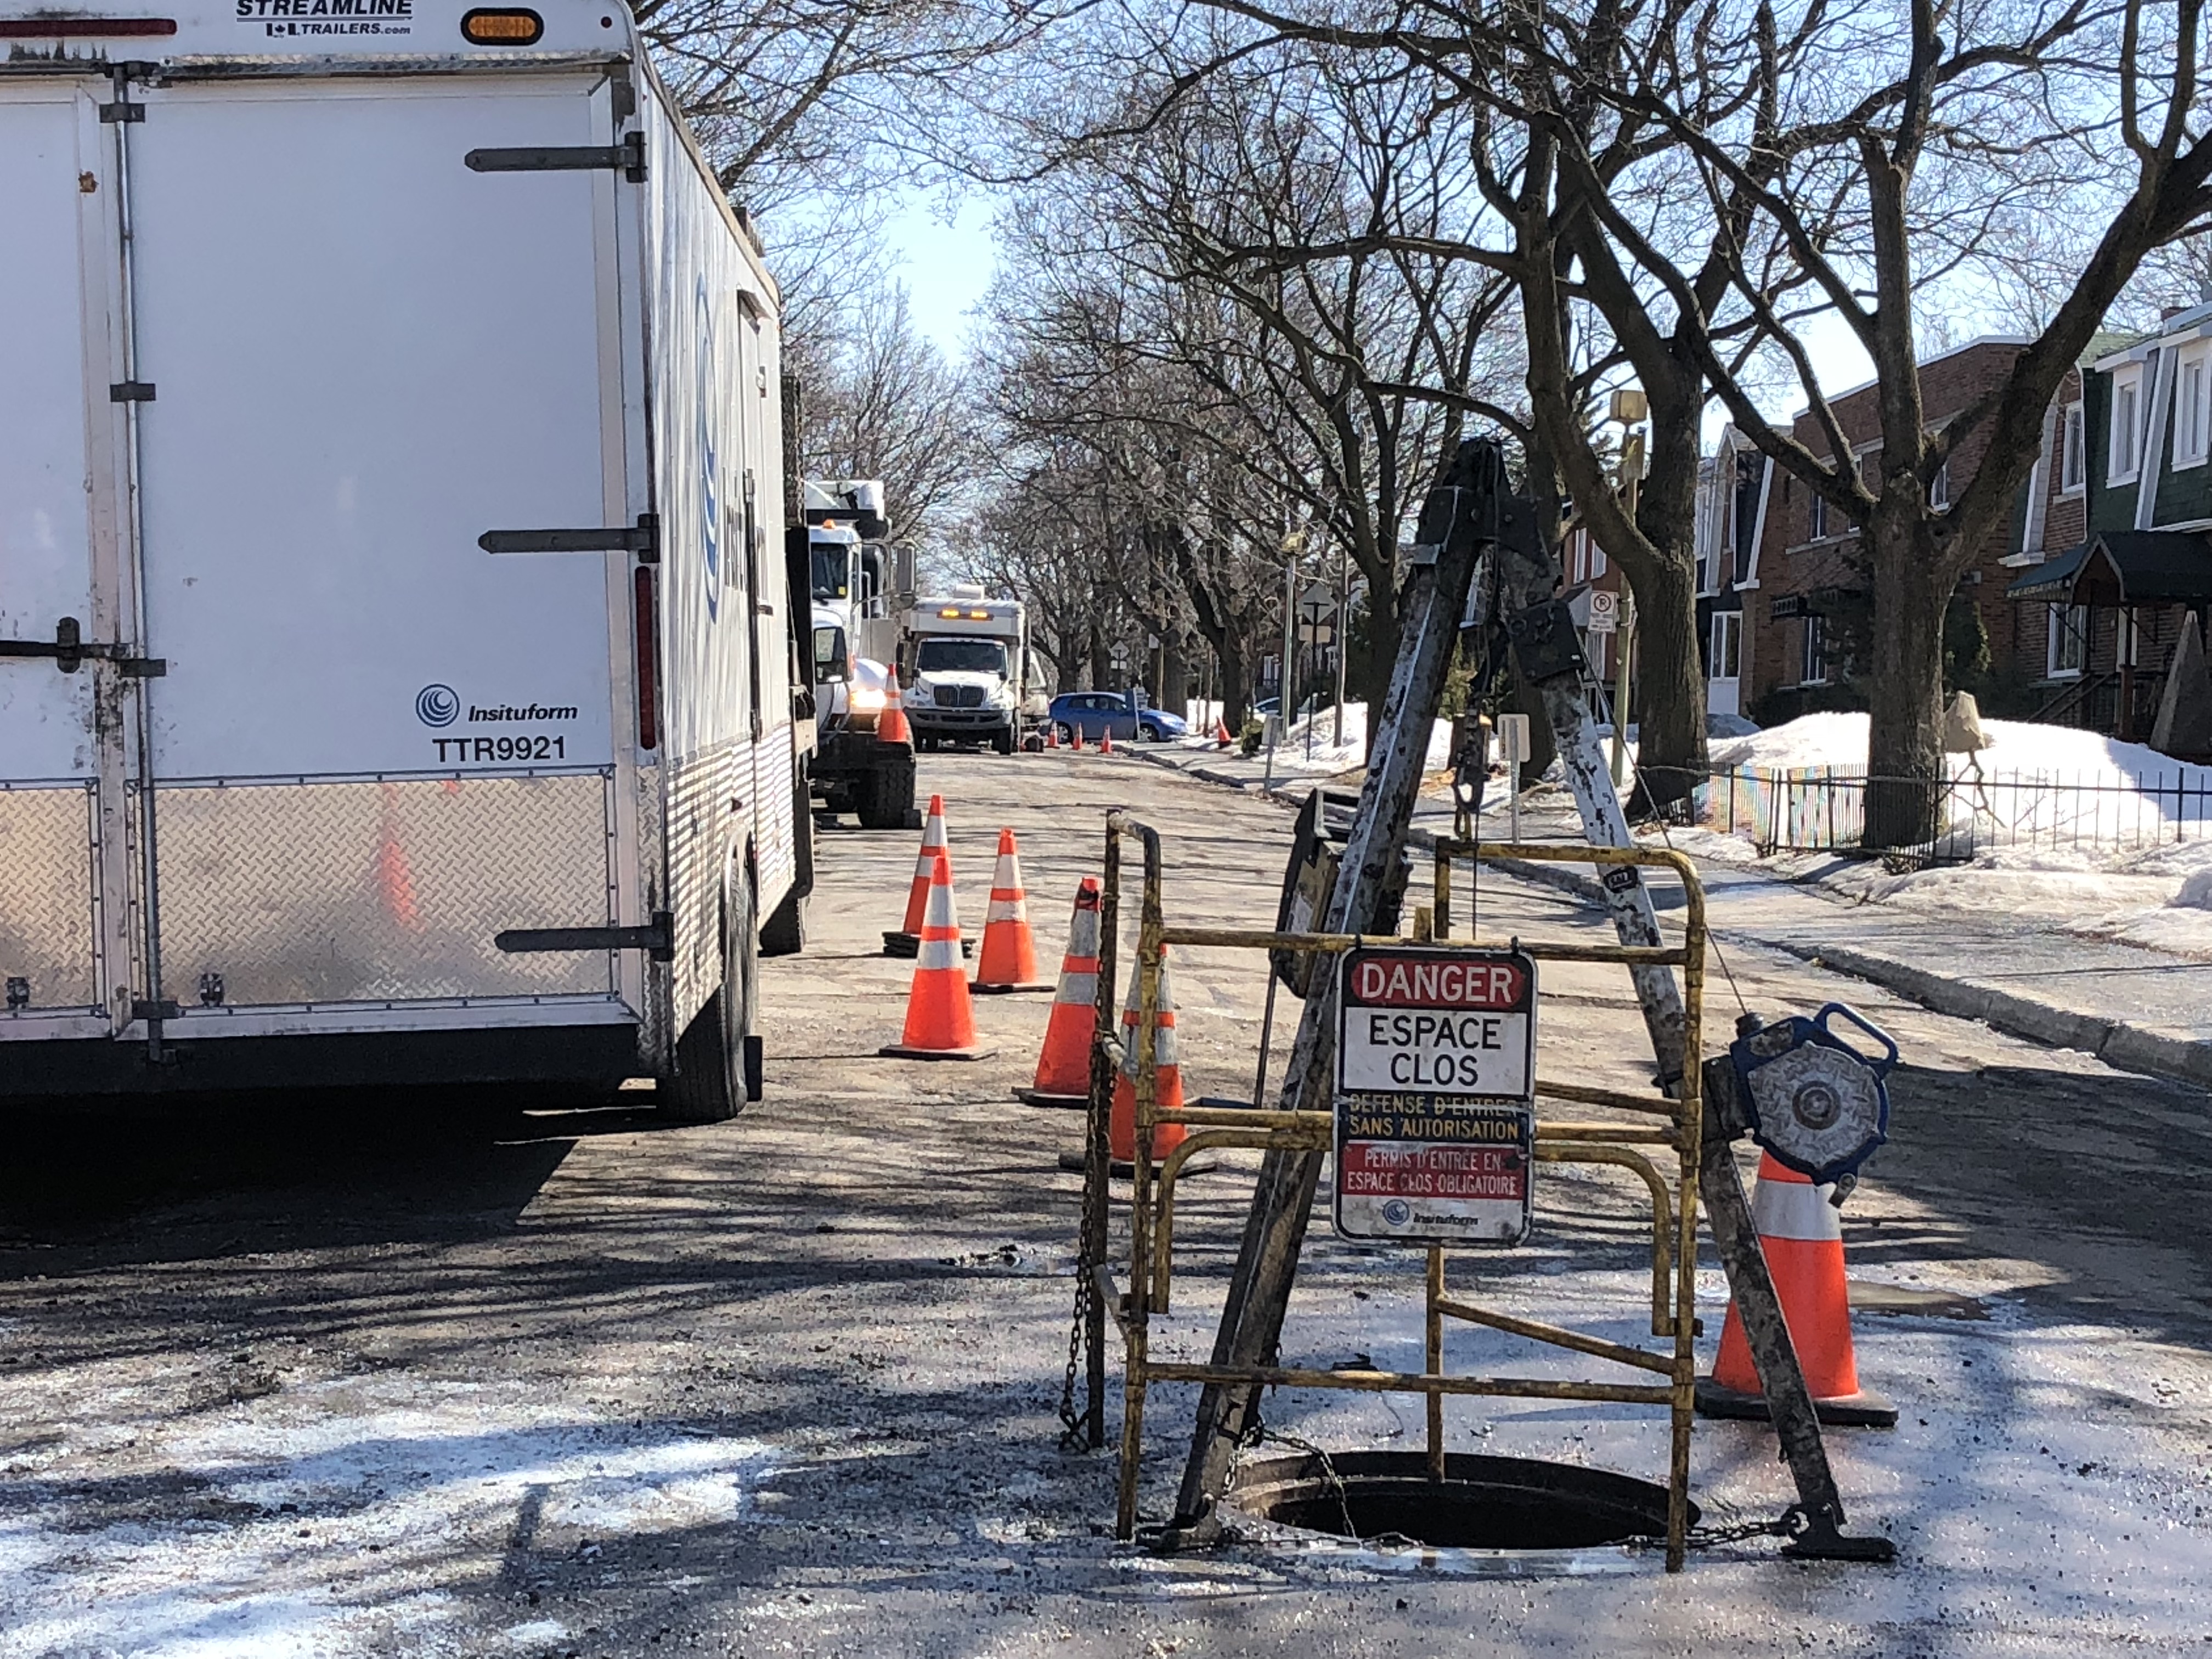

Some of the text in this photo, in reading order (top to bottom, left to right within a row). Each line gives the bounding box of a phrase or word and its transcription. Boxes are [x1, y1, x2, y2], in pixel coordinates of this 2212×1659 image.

[236, 0, 412, 15] STREAMLINE
[301, 23, 411, 35] TRAILERS.com
[469, 703, 578, 721] Insituform
[432, 736, 565, 762] TTR9921
[1362, 962, 1513, 1003] DANGER
[1369, 1014, 1502, 1049] ESPACE
[1390, 1052, 1479, 1086] CLOS
[1348, 1116, 1519, 1139] SANS AUTORISATION
[1364, 1149, 1412, 1169] PERMIS
[1483, 1152, 1501, 1171] EN
[1347, 1171, 1517, 1195] ESPACE CLOS OBLIGATOIRE
